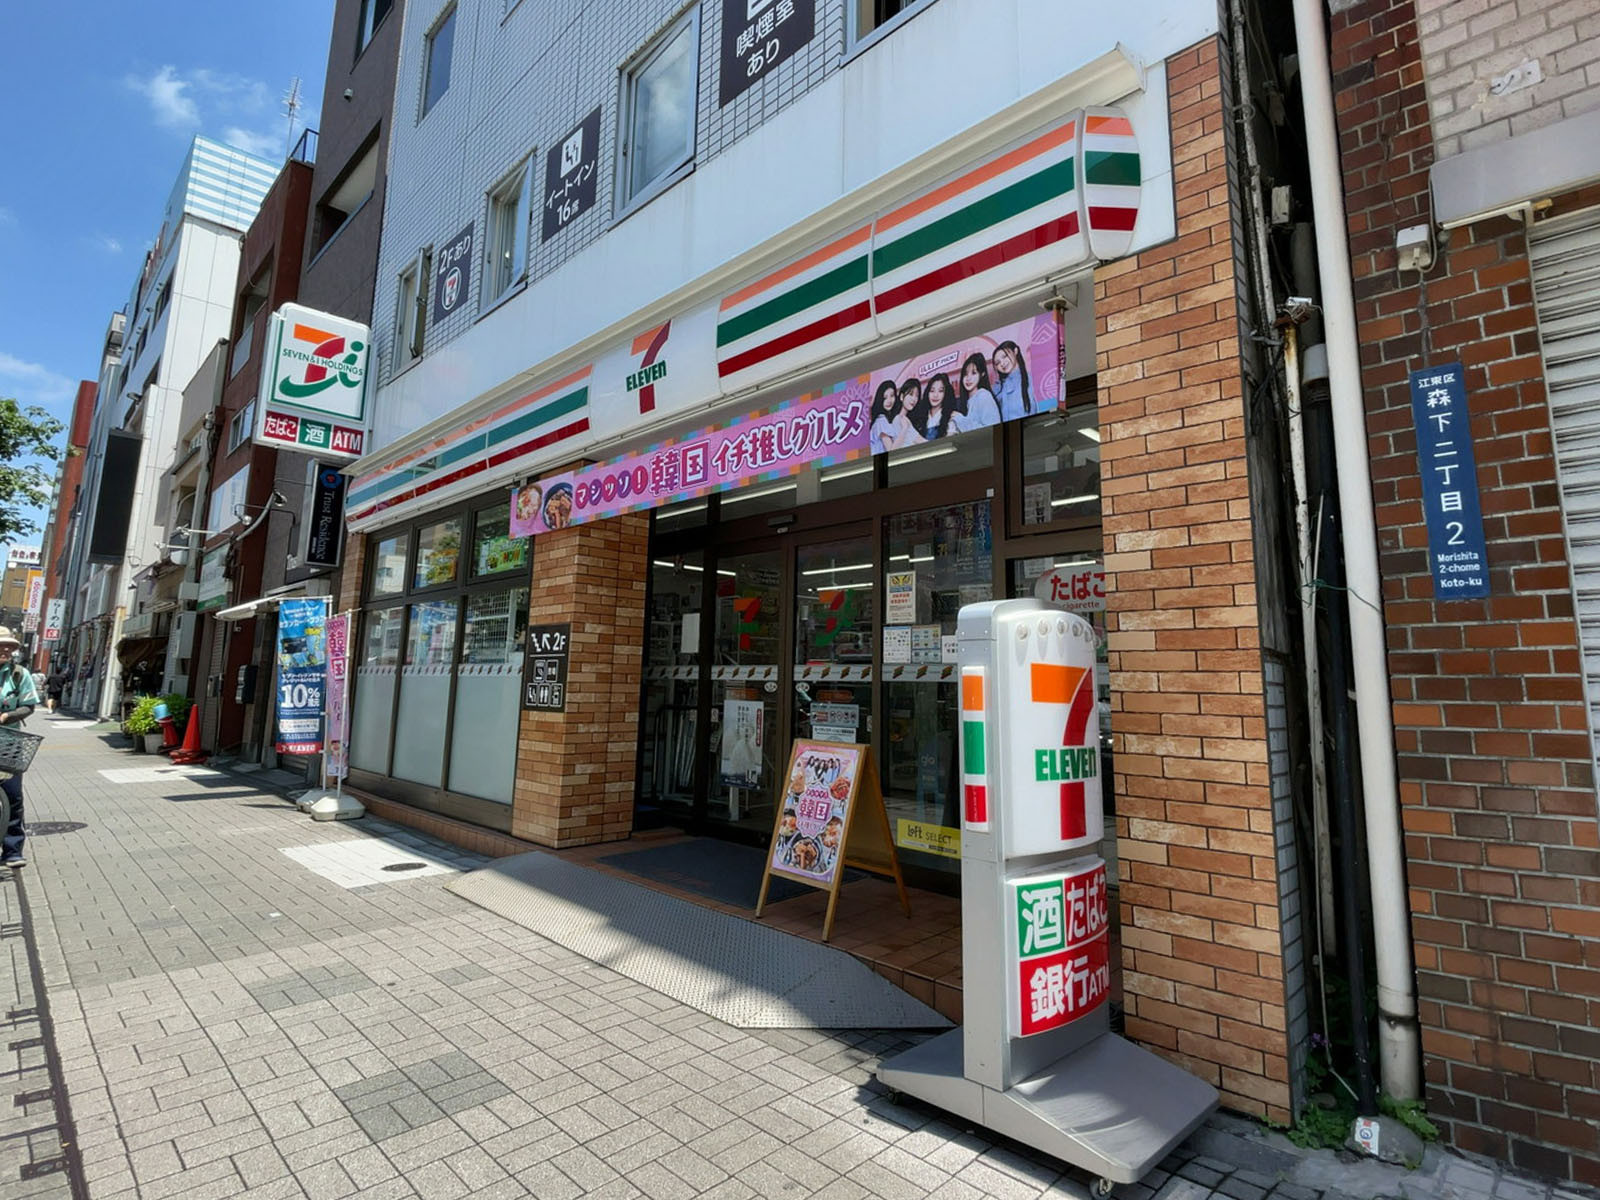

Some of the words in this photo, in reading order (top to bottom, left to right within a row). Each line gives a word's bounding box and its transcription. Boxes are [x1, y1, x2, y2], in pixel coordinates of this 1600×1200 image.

[746, 38, 780, 77] あり
[545, 160, 595, 209] イートイン
[439, 235, 471, 275] 2Fあり
[321, 359, 364, 376] HOLDINGS
[1418, 373, 1456, 389] 江東区
[264, 415, 298, 442] たばこ
[304, 423, 327, 444] 酒
[332, 430, 362, 452] ATM
[649, 440, 709, 496] 韓国
[712, 401, 864, 476] イチ推しグルメ
[1437, 551, 1479, 563] Morishita
[1439, 563, 1480, 574] 2-chome
[1050, 571, 1107, 602] たばこ
[1440, 577, 1483, 589] Koto-ku
[552, 632, 567, 651] 2F
[799, 799, 830, 821] 韓国
[925, 832, 952, 846] SELECT
[1021, 886, 1062, 955] 酒
[1067, 873, 1109, 943] たばこ
[1030, 955, 1090, 1023] 銀行
